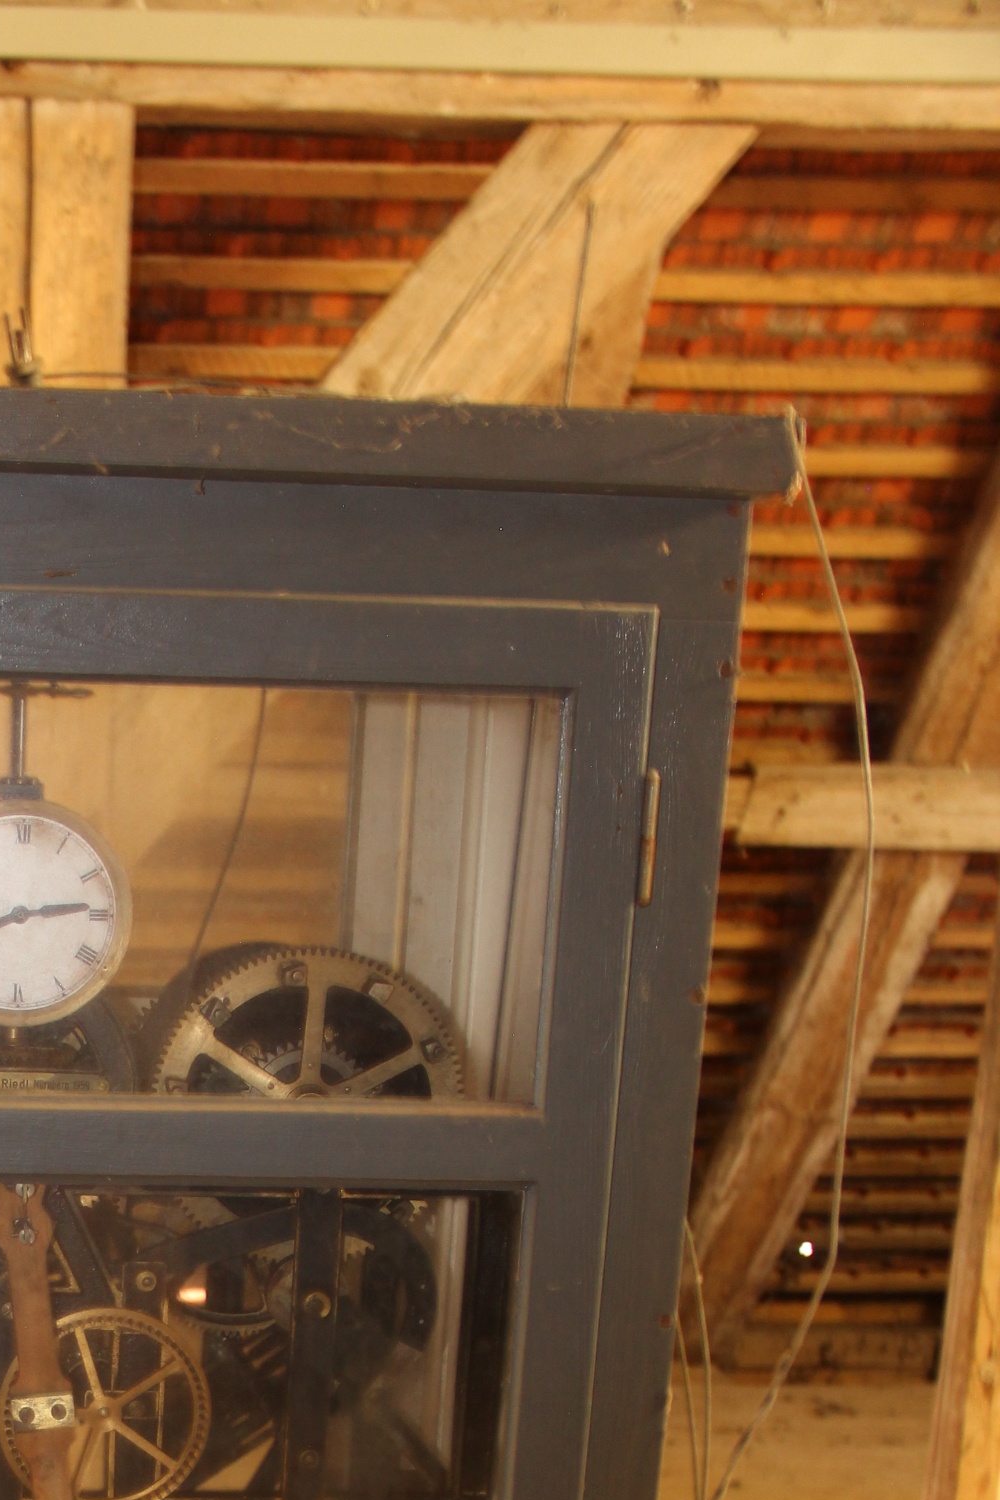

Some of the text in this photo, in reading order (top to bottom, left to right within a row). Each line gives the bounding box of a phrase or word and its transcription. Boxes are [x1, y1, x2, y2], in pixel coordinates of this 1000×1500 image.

[80, 868, 99, 883] II
[89, 909, 109, 921] III
[75, 944, 98, 966] IIII
[1, 1078, 30, 1089] Riedl
[33, 1080, 70, 1091] Nürnberg
